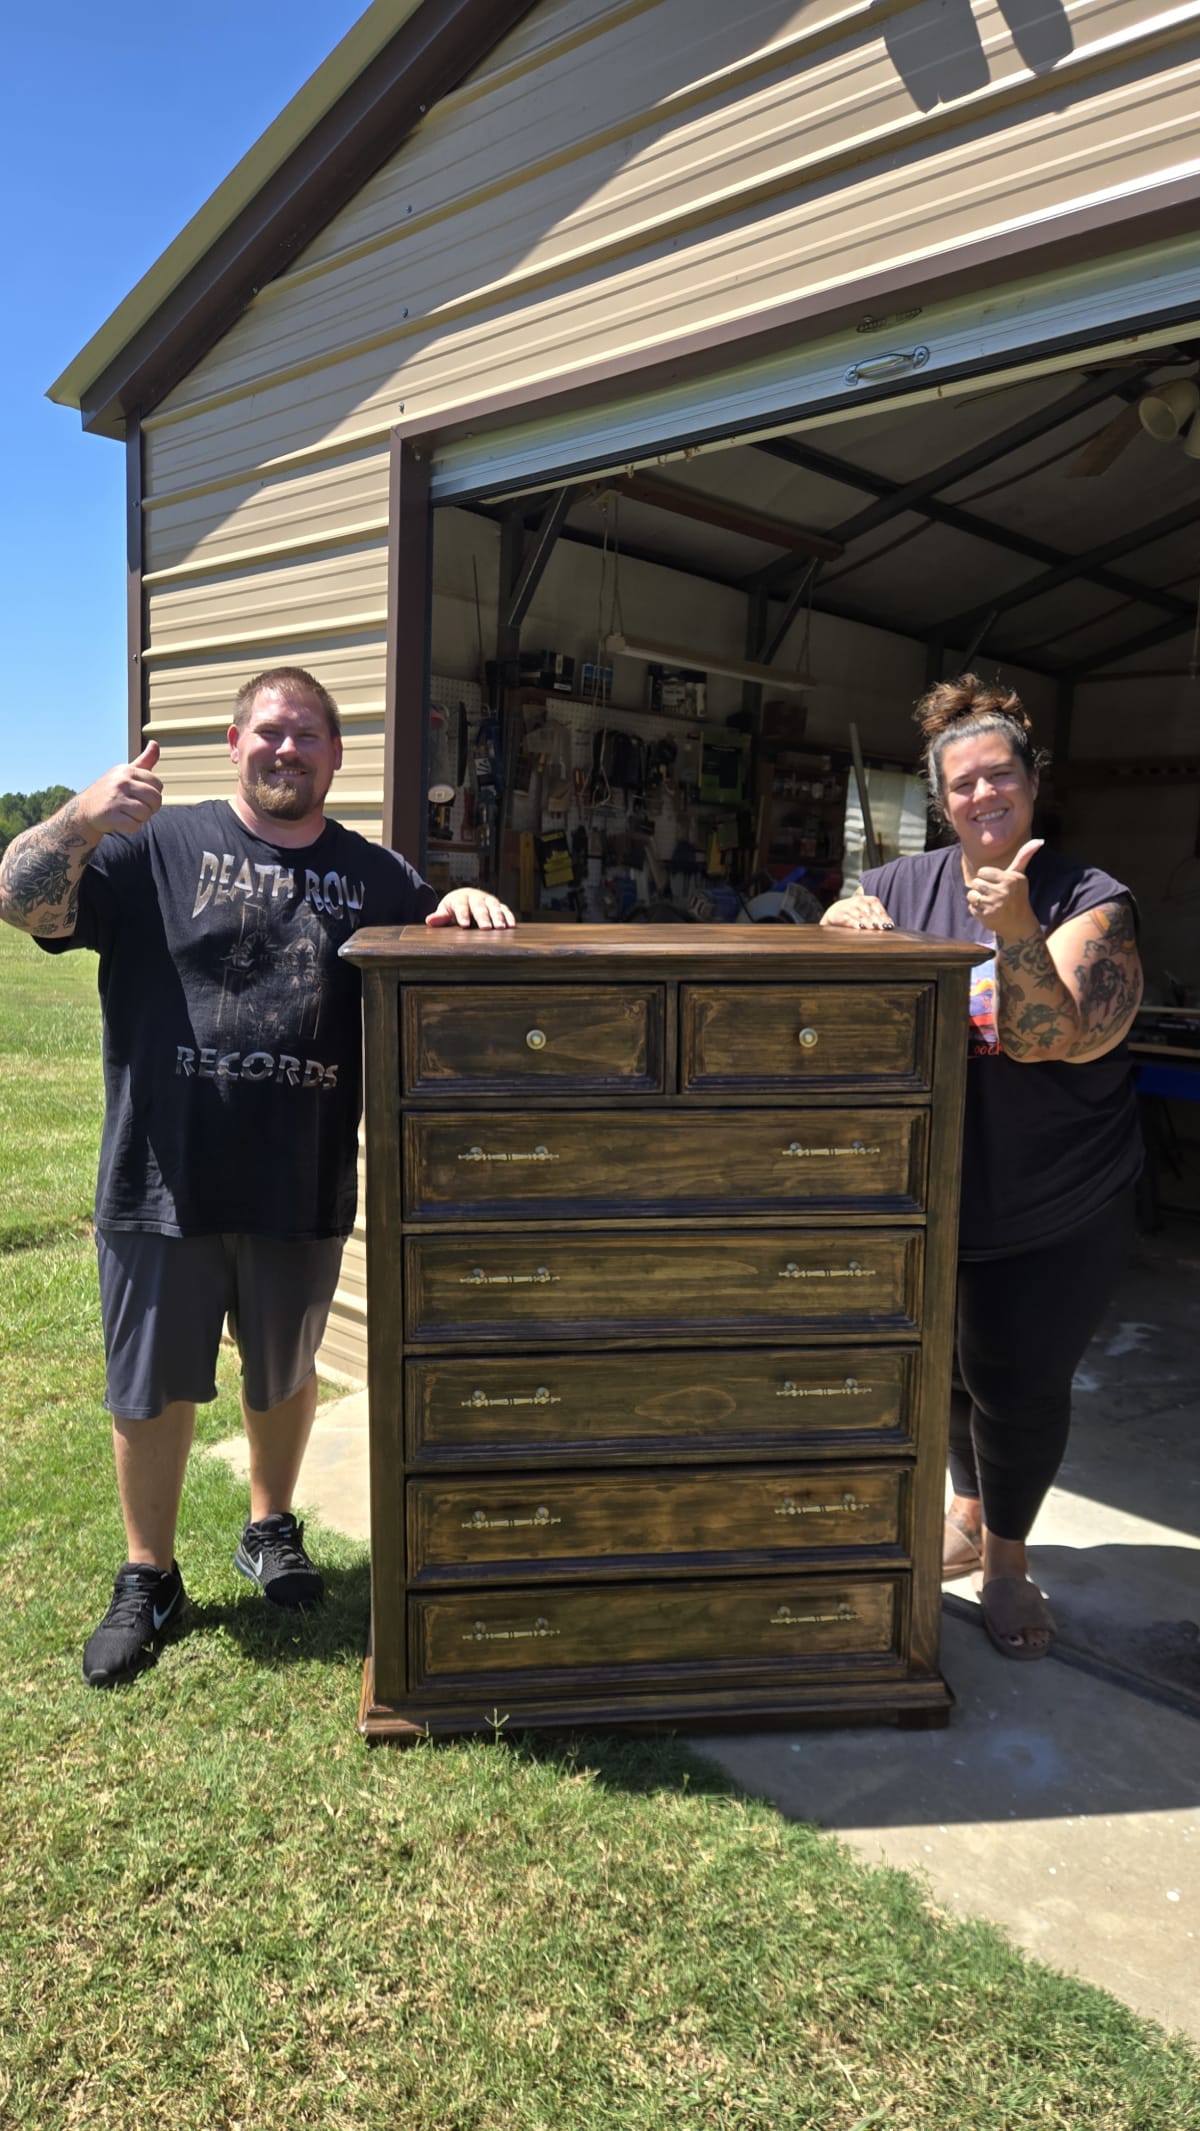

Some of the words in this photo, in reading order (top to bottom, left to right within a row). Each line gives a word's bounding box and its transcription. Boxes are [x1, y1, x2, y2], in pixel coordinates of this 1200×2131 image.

[192, 850, 294, 919] DEATH
[304, 869, 365, 920] ROW
[175, 1045, 339, 1089] RECORDS
